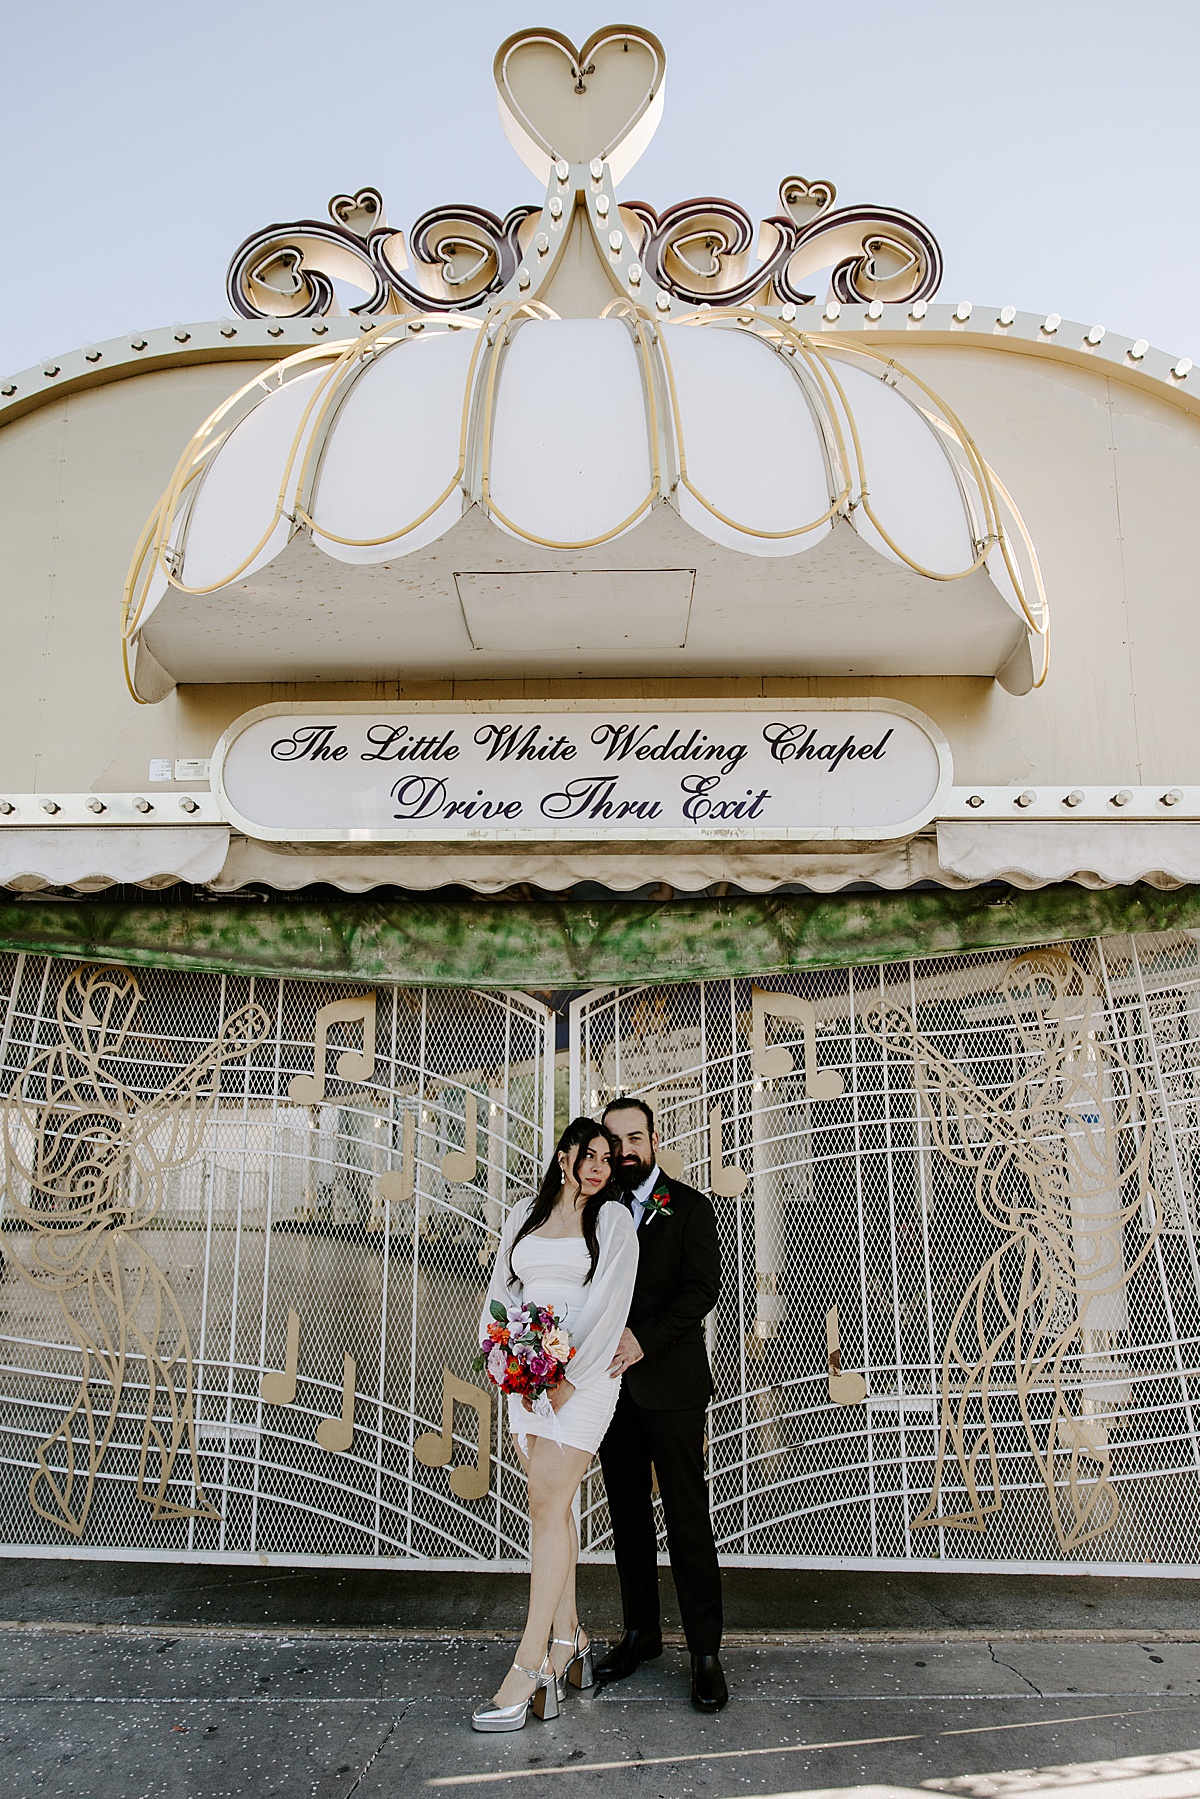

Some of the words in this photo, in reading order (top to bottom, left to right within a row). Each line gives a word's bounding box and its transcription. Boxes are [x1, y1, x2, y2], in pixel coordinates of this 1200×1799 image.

[271, 724, 348, 762] The
[361, 723, 460, 762] Little
[474, 723, 577, 762] White
[591, 723, 748, 776] Wedding
[763, 722, 894, 773] Chapel
[390, 774, 523, 820] Drive
[540, 775, 663, 820] Thru
[680, 774, 772, 825] Exit
